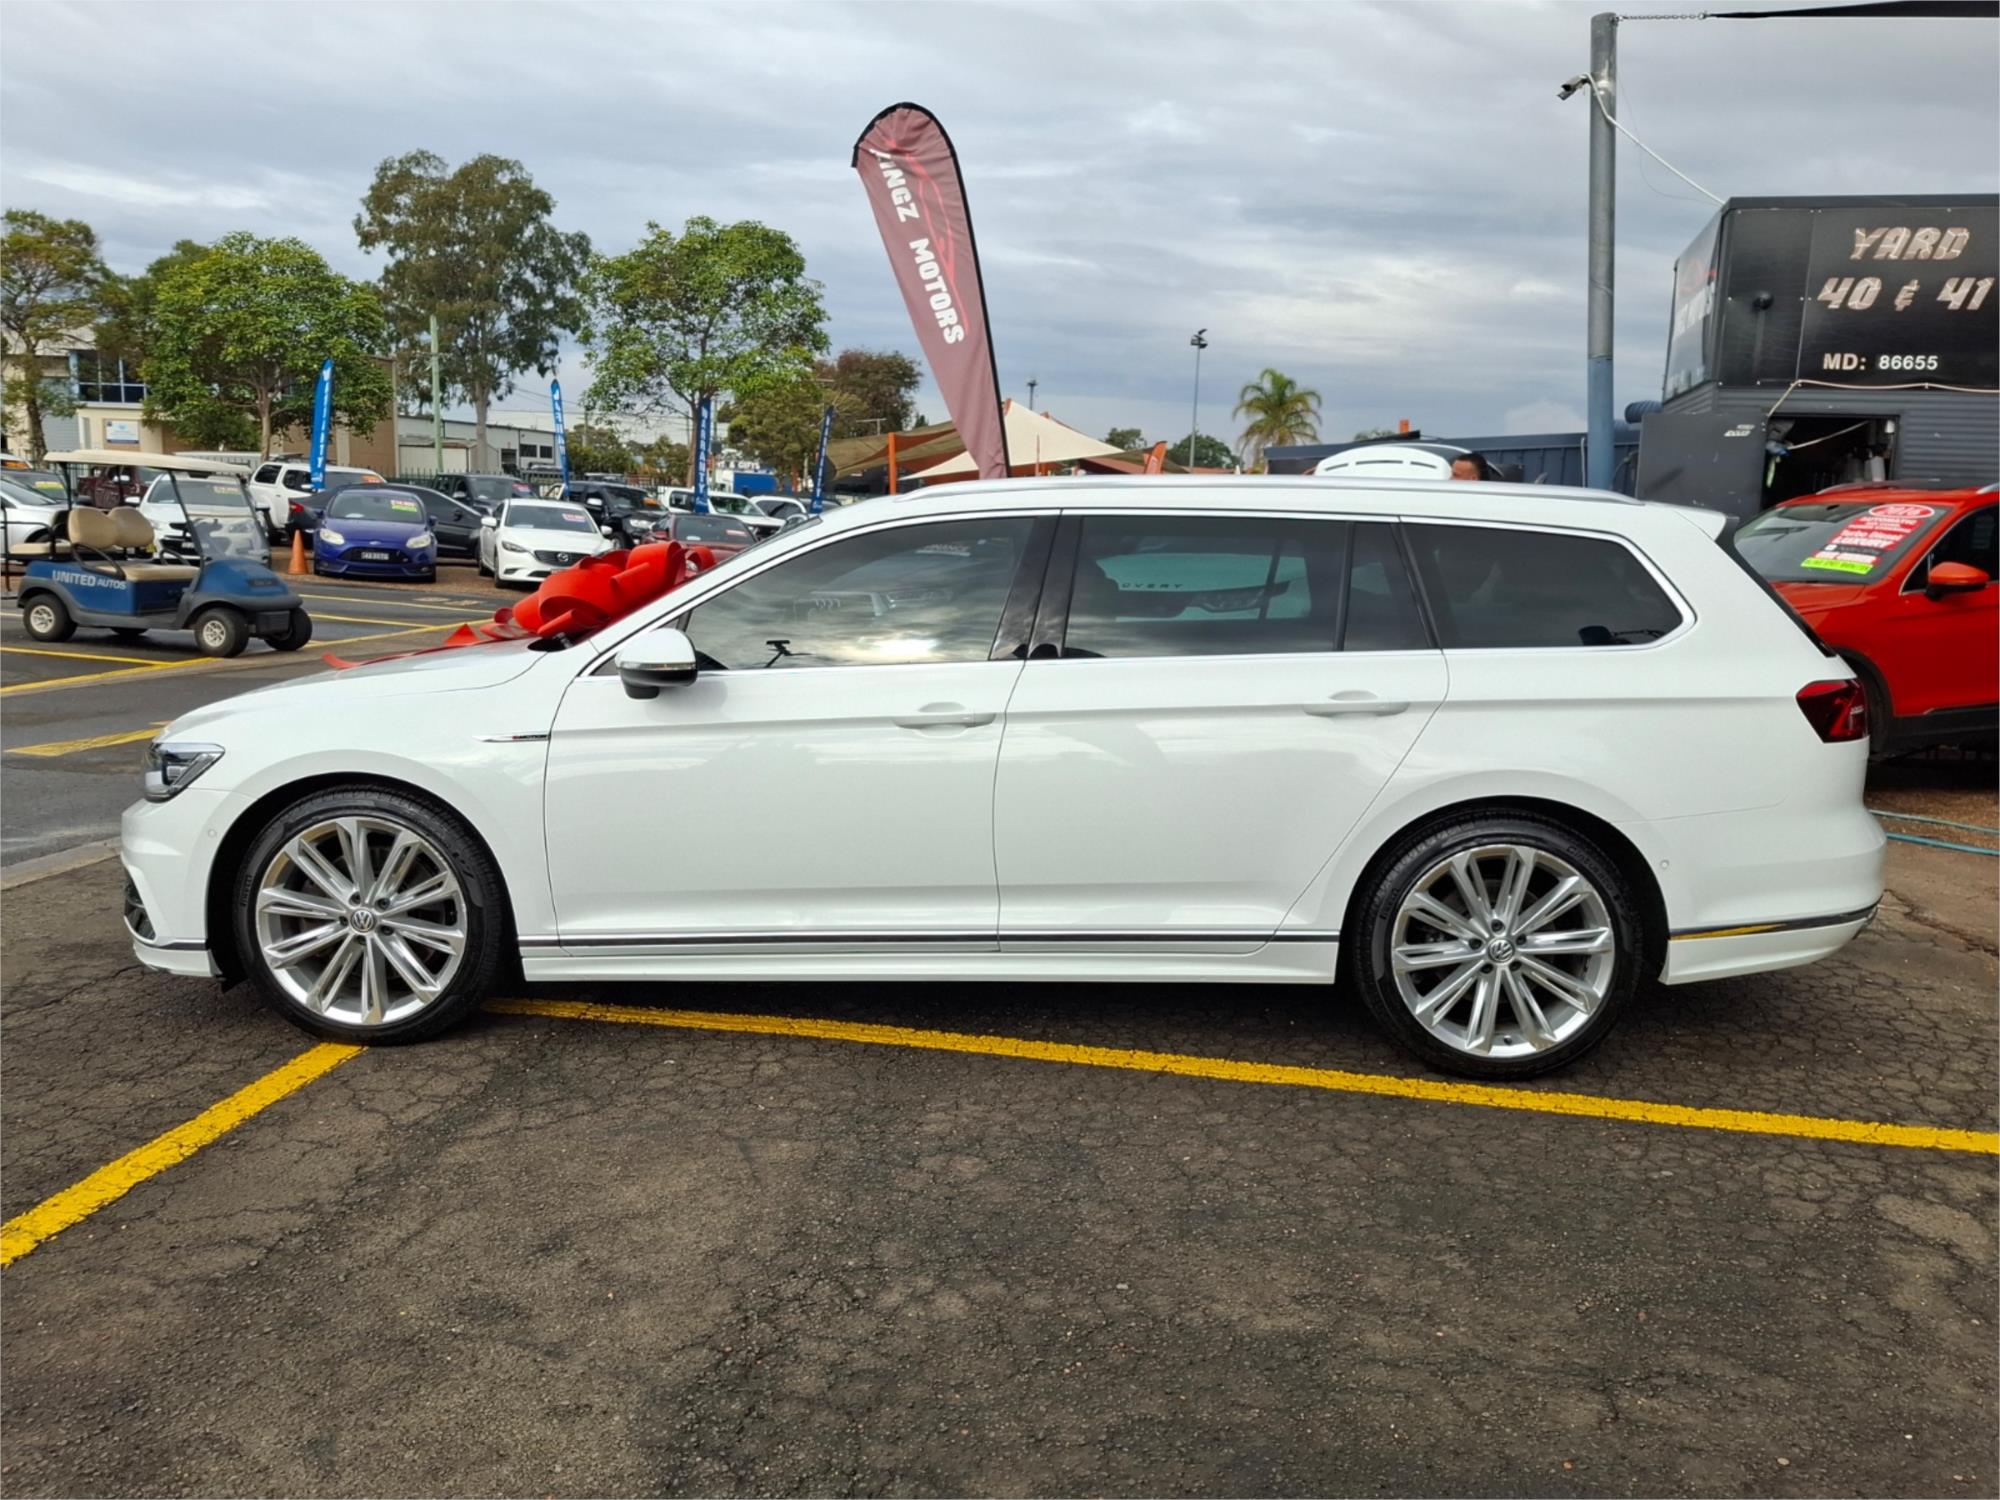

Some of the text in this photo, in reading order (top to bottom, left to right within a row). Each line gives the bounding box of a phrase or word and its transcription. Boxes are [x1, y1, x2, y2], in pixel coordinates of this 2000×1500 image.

[1850, 226, 1970, 260] YARD
[909, 237, 965, 345] MOTORS
[1817, 277, 1995, 311] 40 & 41
[1823, 353, 1938, 370] MD: 86655
[52, 570, 127, 590] UNITED AUTOS
